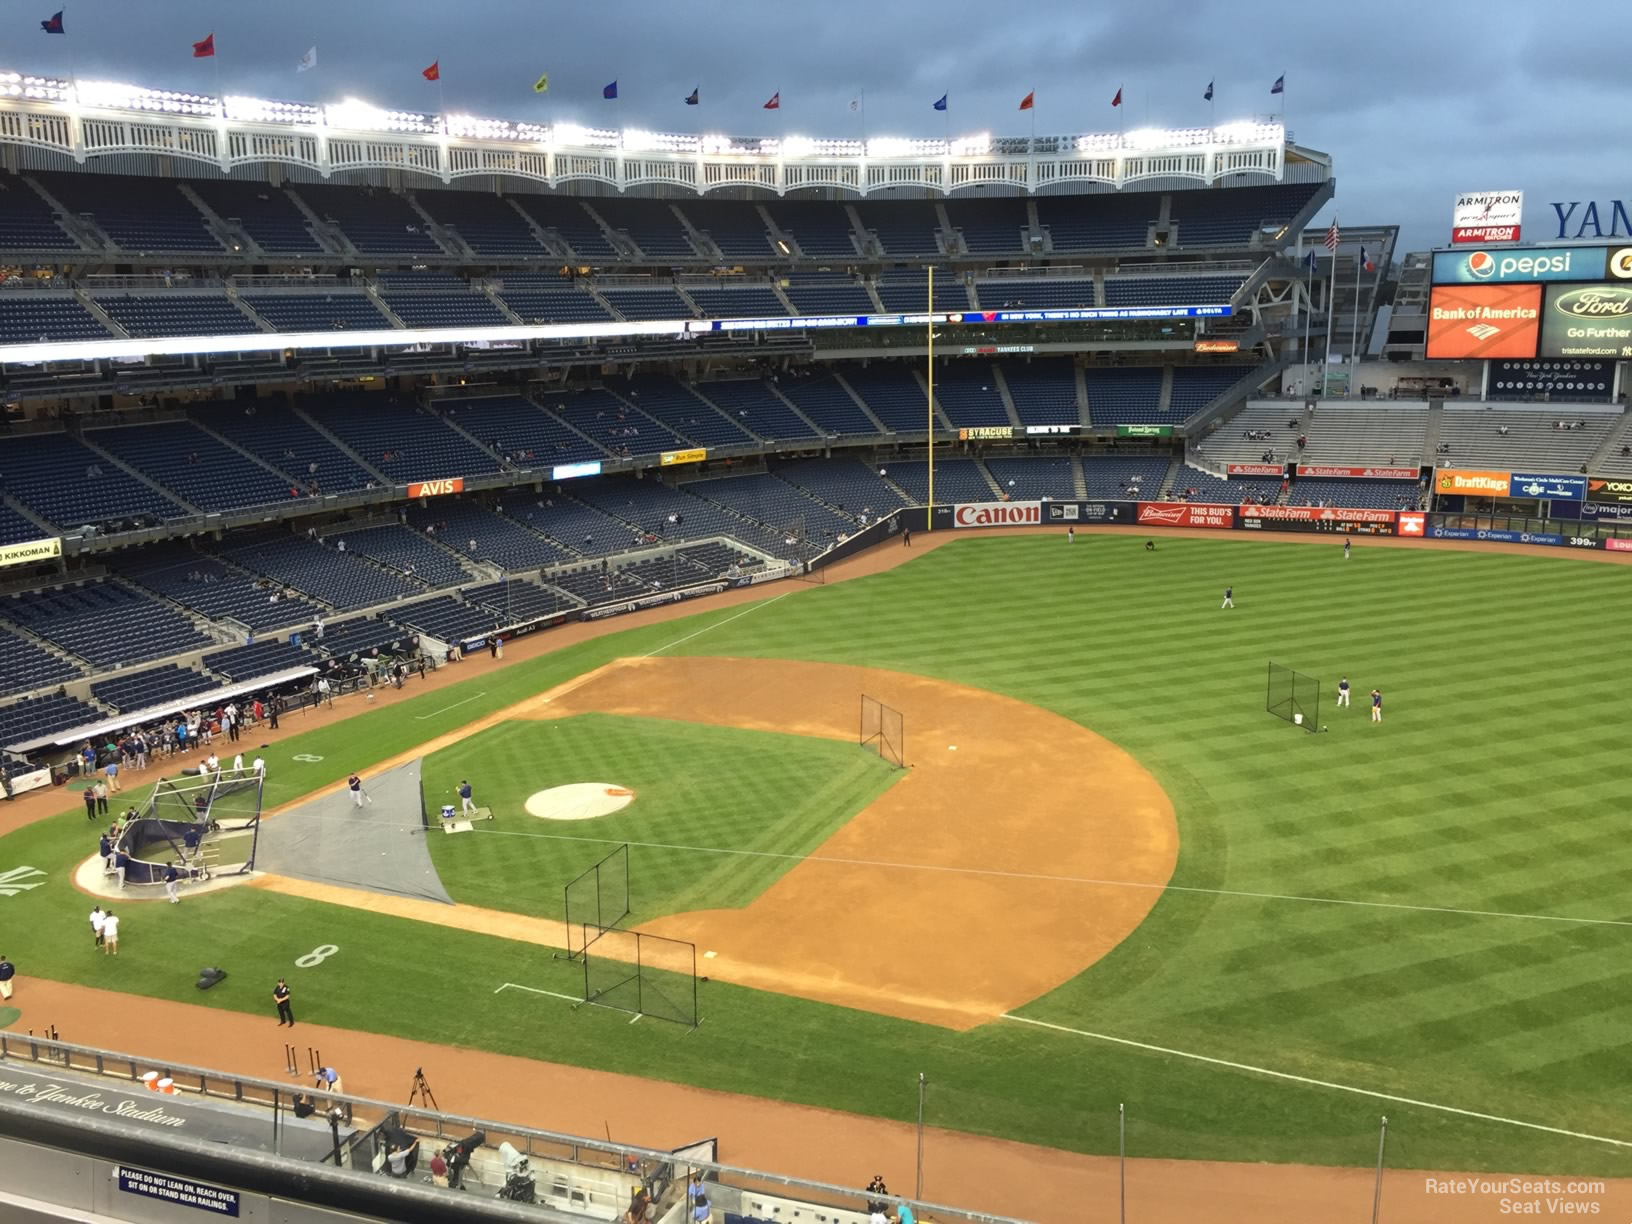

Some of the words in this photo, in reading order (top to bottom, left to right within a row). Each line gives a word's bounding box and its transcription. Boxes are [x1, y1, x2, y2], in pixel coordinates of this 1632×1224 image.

[1458, 196, 1520, 206] ARMITRON
[1458, 227, 1516, 237] ARMITRON
[1500, 252, 1571, 278] pepsi
[1573, 292, 1630, 313] Ford
[1433, 307, 1465, 320] Bank
[1467, 307, 1481, 319] of
[1482, 306, 1536, 319] America
[1568, 328, 1584, 337] Go
[1586, 328, 1631, 337] Further
[1195, 343, 1237, 352] Budweiser
[968, 428, 1013, 436] SYRACUSE
[419, 480, 454, 496] AVIS
[1455, 476, 1508, 490] DraftKings
[956, 506, 1039, 525] Canon
[1190, 507, 1207, 515] THIS
[1209, 508, 1232, 516] BUD'S
[1207, 517, 1224, 525] YOU.
[1530, 535, 1556, 543] Experian
[5, 547, 50, 560] KIKKOMAN
[467, 640, 486, 650] GEICO
[292, 754, 324, 763] 8
[295, 944, 339, 968] 8
[15, 1083, 38, 1095] to
[26, 1084, 104, 1110] Yankee
[102, 1100, 186, 1127] Stadium
[121, 1170, 143, 1181] PLEASE
[144, 1175, 152, 1183] DO
[154, 1177, 166, 1186] NOT
[167, 1180, 183, 1191] LEAN
[184, 1183, 195, 1194] ON,
[196, 1186, 216, 1198] REACH
[218, 1192, 236, 1203] OVER,
[128, 1181, 138, 1189] SIT
[139, 1183, 148, 1192] ON
[149, 1185, 157, 1193] OR
[158, 1188, 179, 1199] STAND
[180, 1193, 196, 1203] NEAR
[198, 1197, 228, 1210] RAILINGS.
